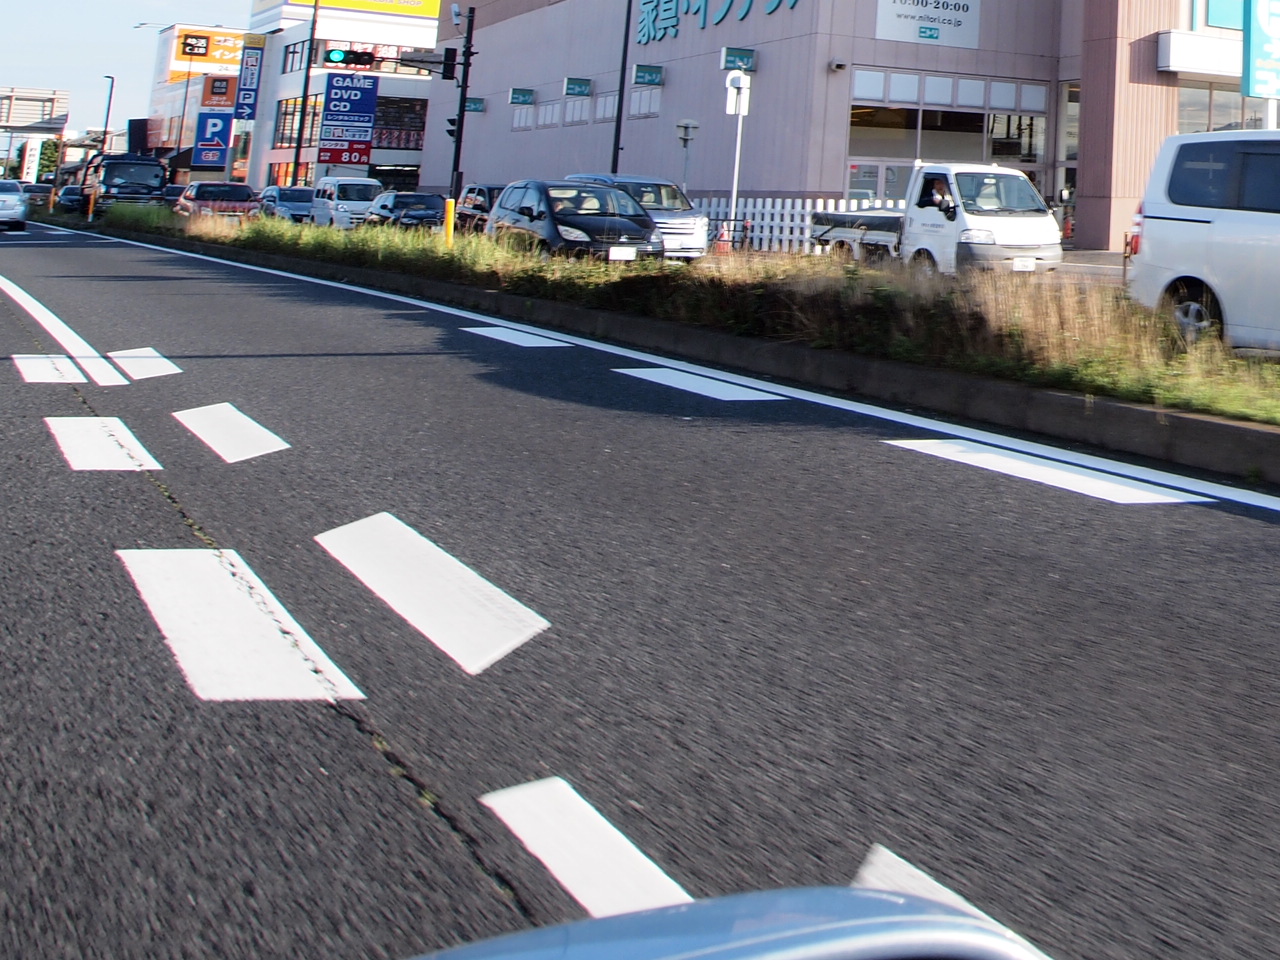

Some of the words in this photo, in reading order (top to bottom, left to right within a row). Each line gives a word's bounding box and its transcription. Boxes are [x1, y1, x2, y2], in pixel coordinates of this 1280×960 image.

[896, 13, 963, 27] www.nitori.co.jp
[636, 72, 661, 82] ニトリ
[332, 77, 374, 89] GAME
[330, 89, 361, 100] DVD
[567, 85, 590, 95] ニトリ
[242, 93, 252, 102] P
[513, 94, 533, 103] ニトリ
[329, 101, 351, 111] CD
[205, 118, 224, 139] P
